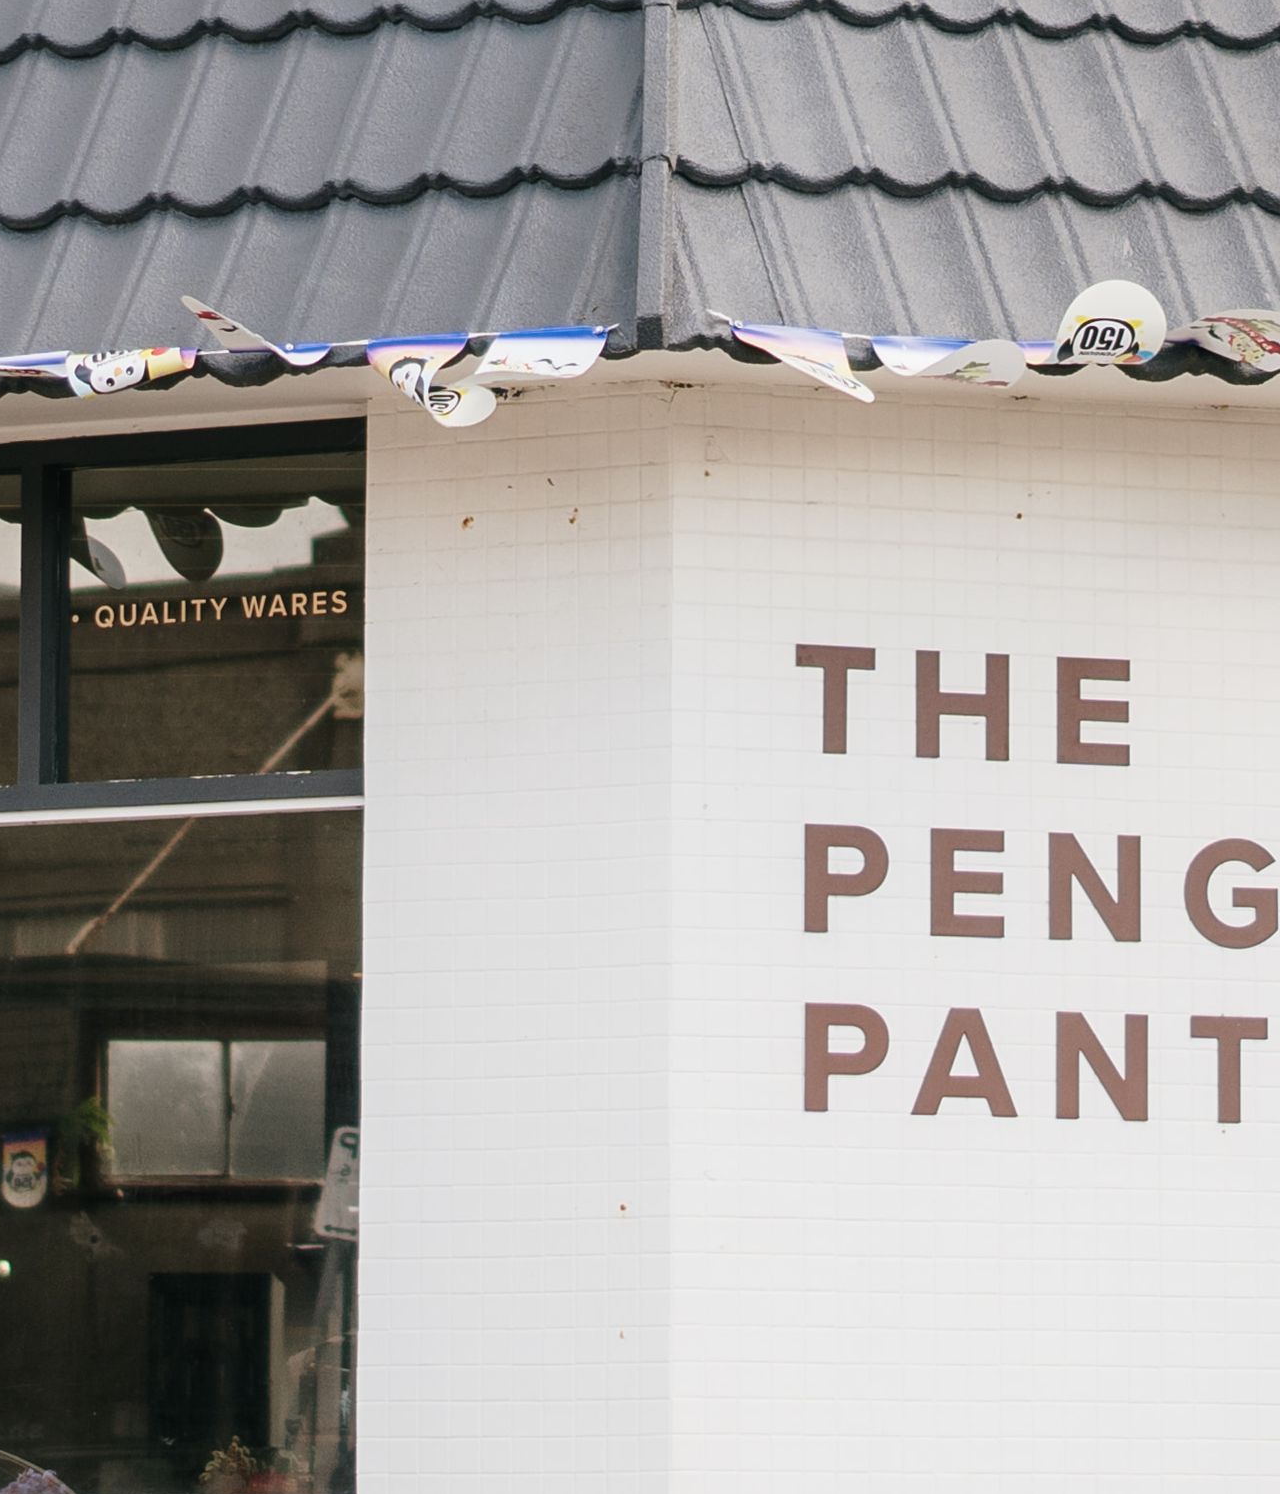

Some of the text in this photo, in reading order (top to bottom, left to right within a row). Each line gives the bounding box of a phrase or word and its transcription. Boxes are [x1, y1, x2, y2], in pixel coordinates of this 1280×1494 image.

[1080, 325, 1126, 351] 150
[95, 590, 348, 628] QUALITY WARES
[795, 643, 1131, 766] THE
